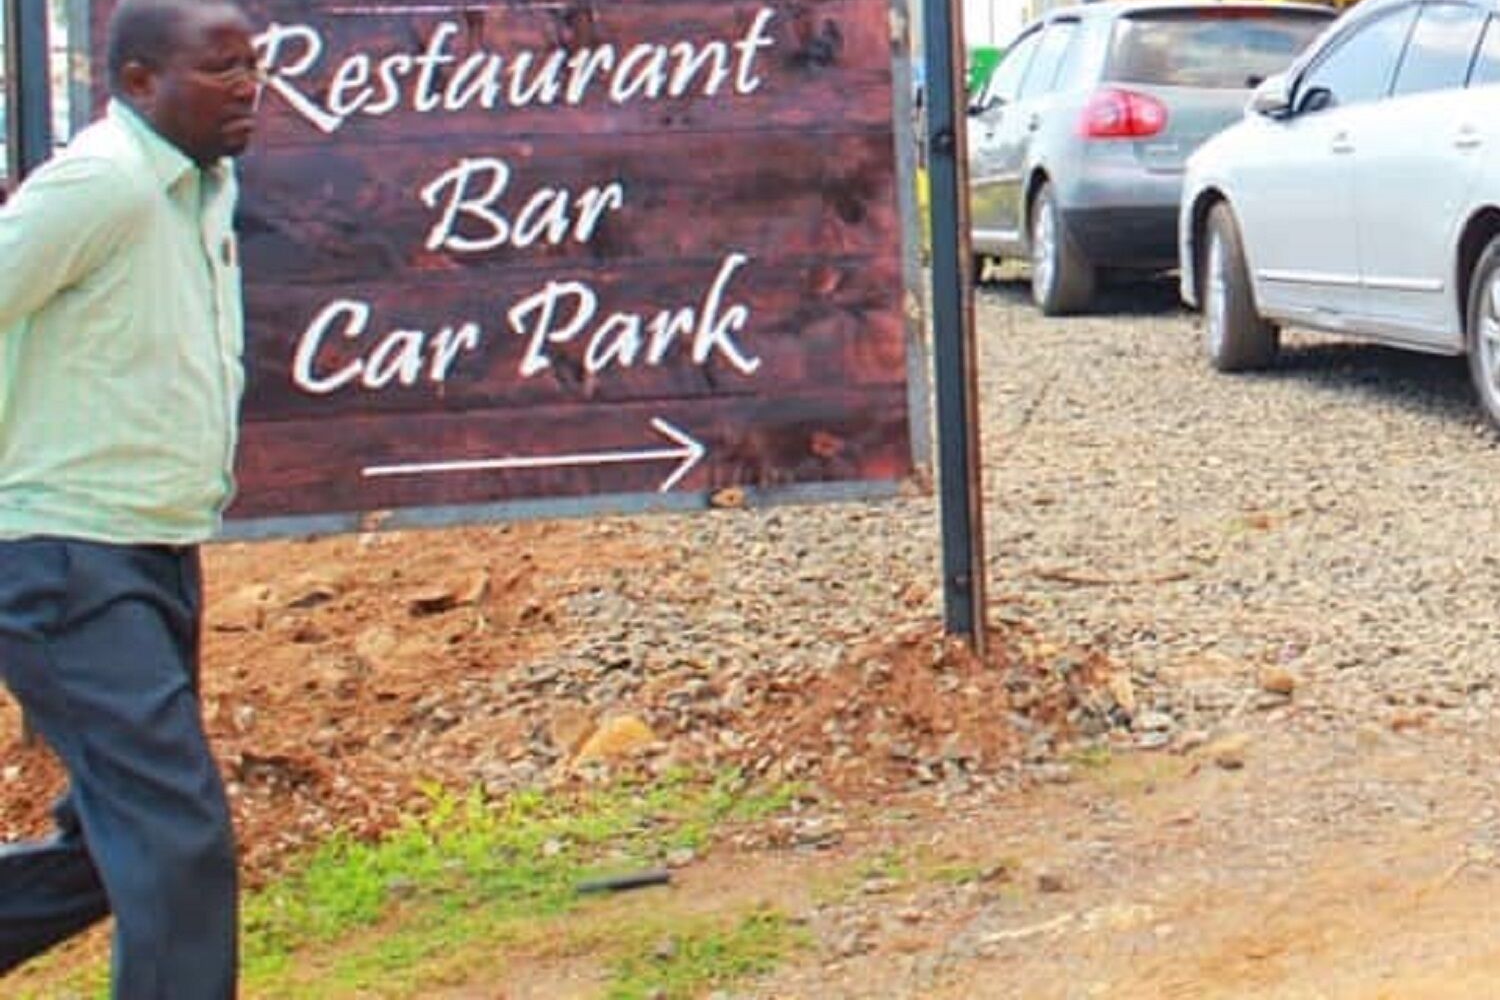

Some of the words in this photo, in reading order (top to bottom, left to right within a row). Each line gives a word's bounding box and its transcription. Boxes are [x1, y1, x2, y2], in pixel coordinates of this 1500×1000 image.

[251, 9, 775, 132] Restaurant
[421, 157, 623, 252] Bar
[293, 300, 479, 394] Car
[509, 254, 760, 375] Park
